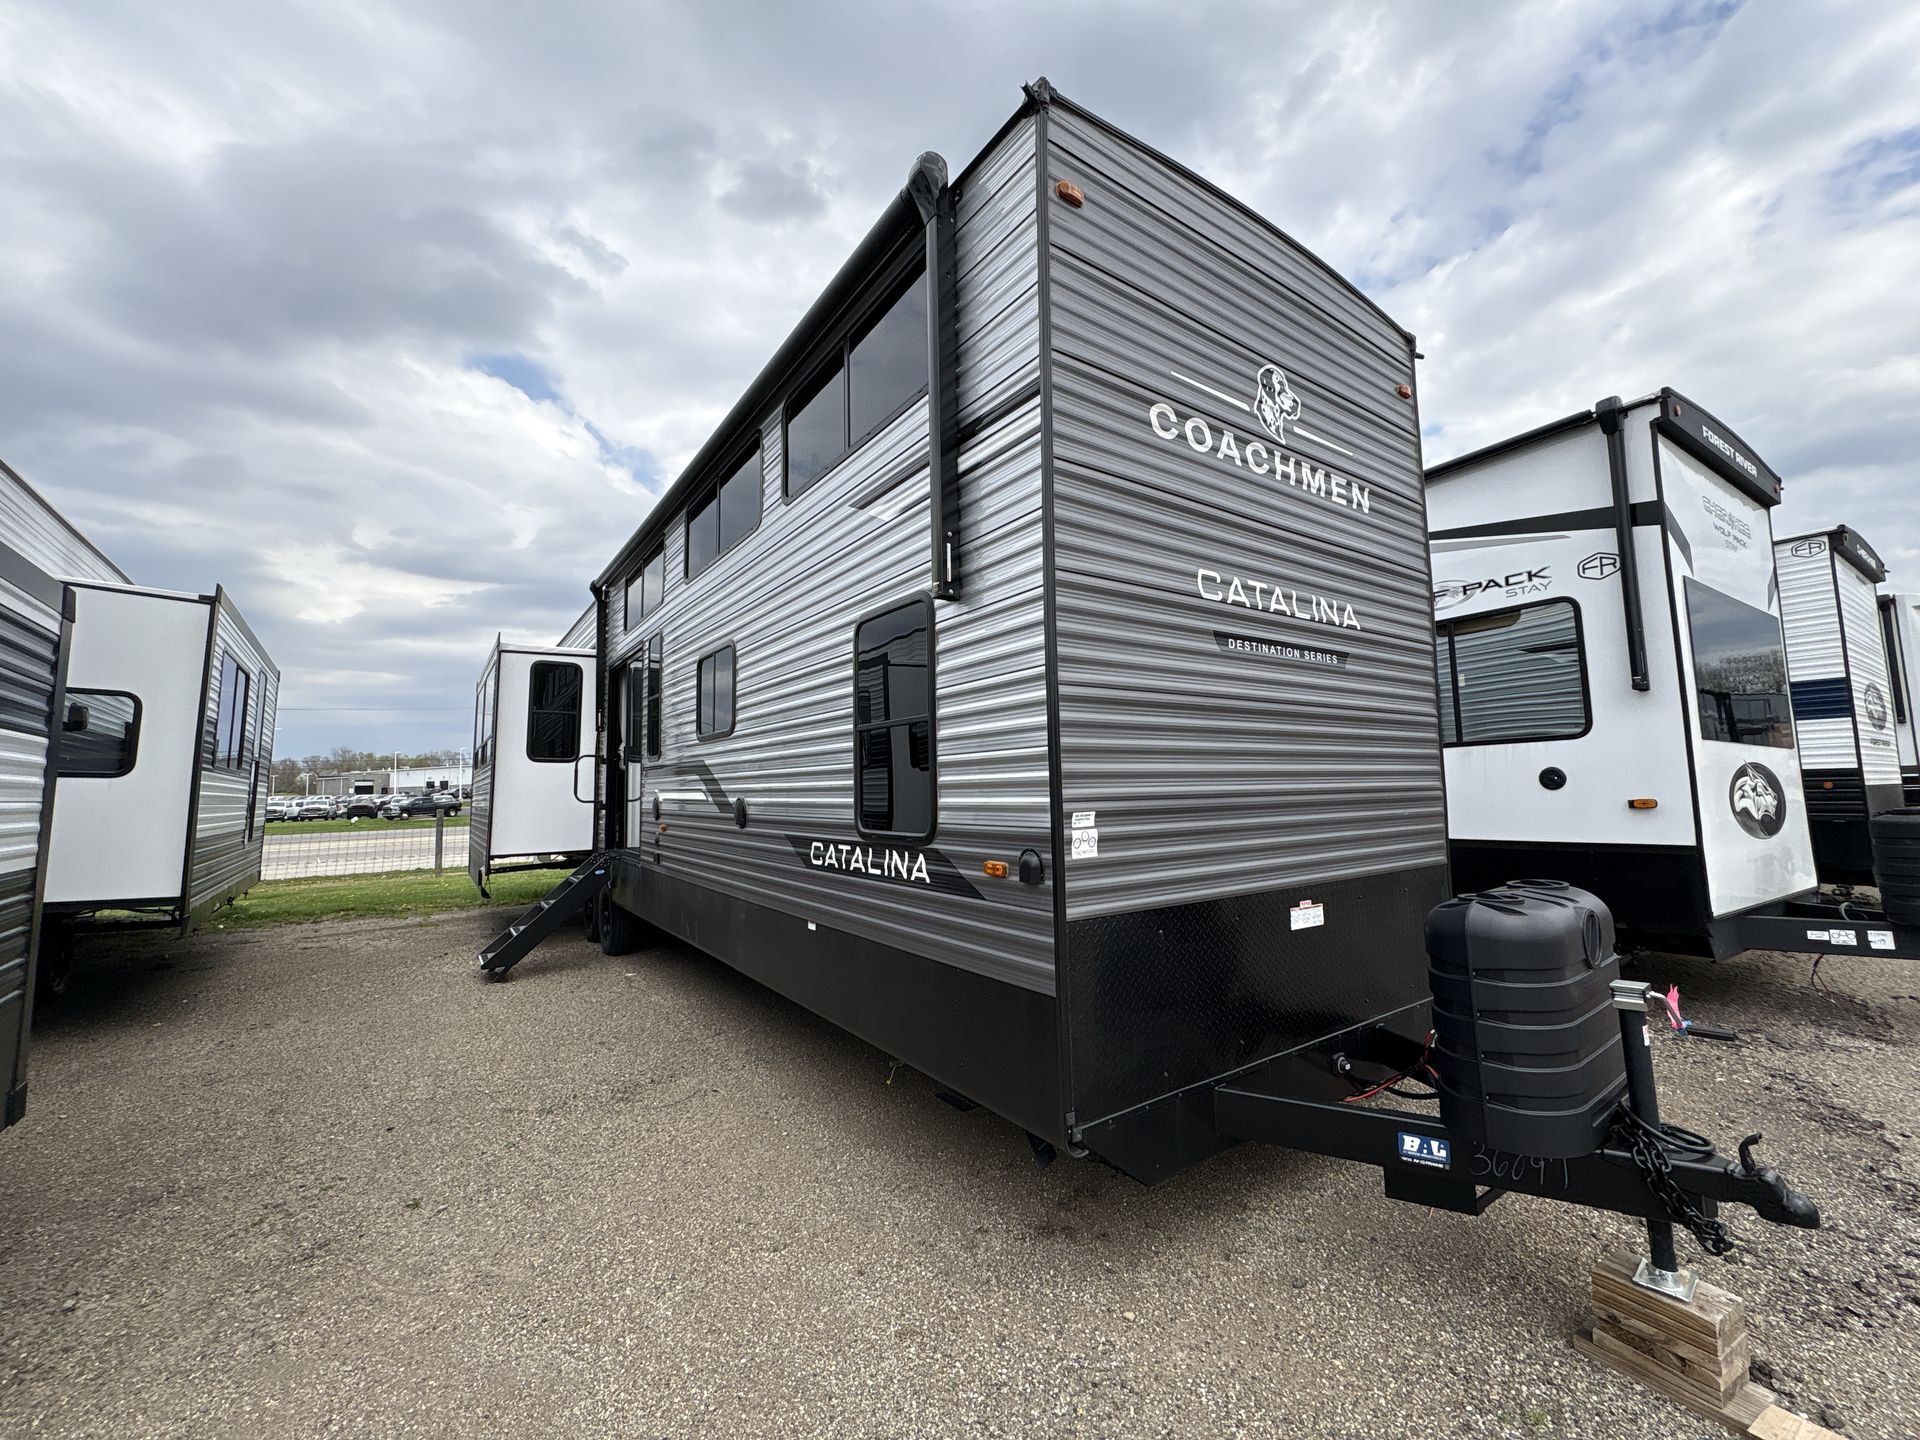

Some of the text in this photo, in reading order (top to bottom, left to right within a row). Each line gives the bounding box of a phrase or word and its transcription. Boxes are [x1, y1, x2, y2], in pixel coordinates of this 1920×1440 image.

[1149, 402, 1370, 514] COACHMEN
[1702, 425, 1758, 477] FOREST RIVER
[1197, 568, 1361, 630] CATALINA
[1462, 565, 1552, 597] PACK
[1505, 580, 1553, 599] STAY
[1228, 638, 1338, 664] DESTINATION SERIES
[810, 841, 931, 884] CATALINA
[1402, 1134, 1447, 1158] BAL
